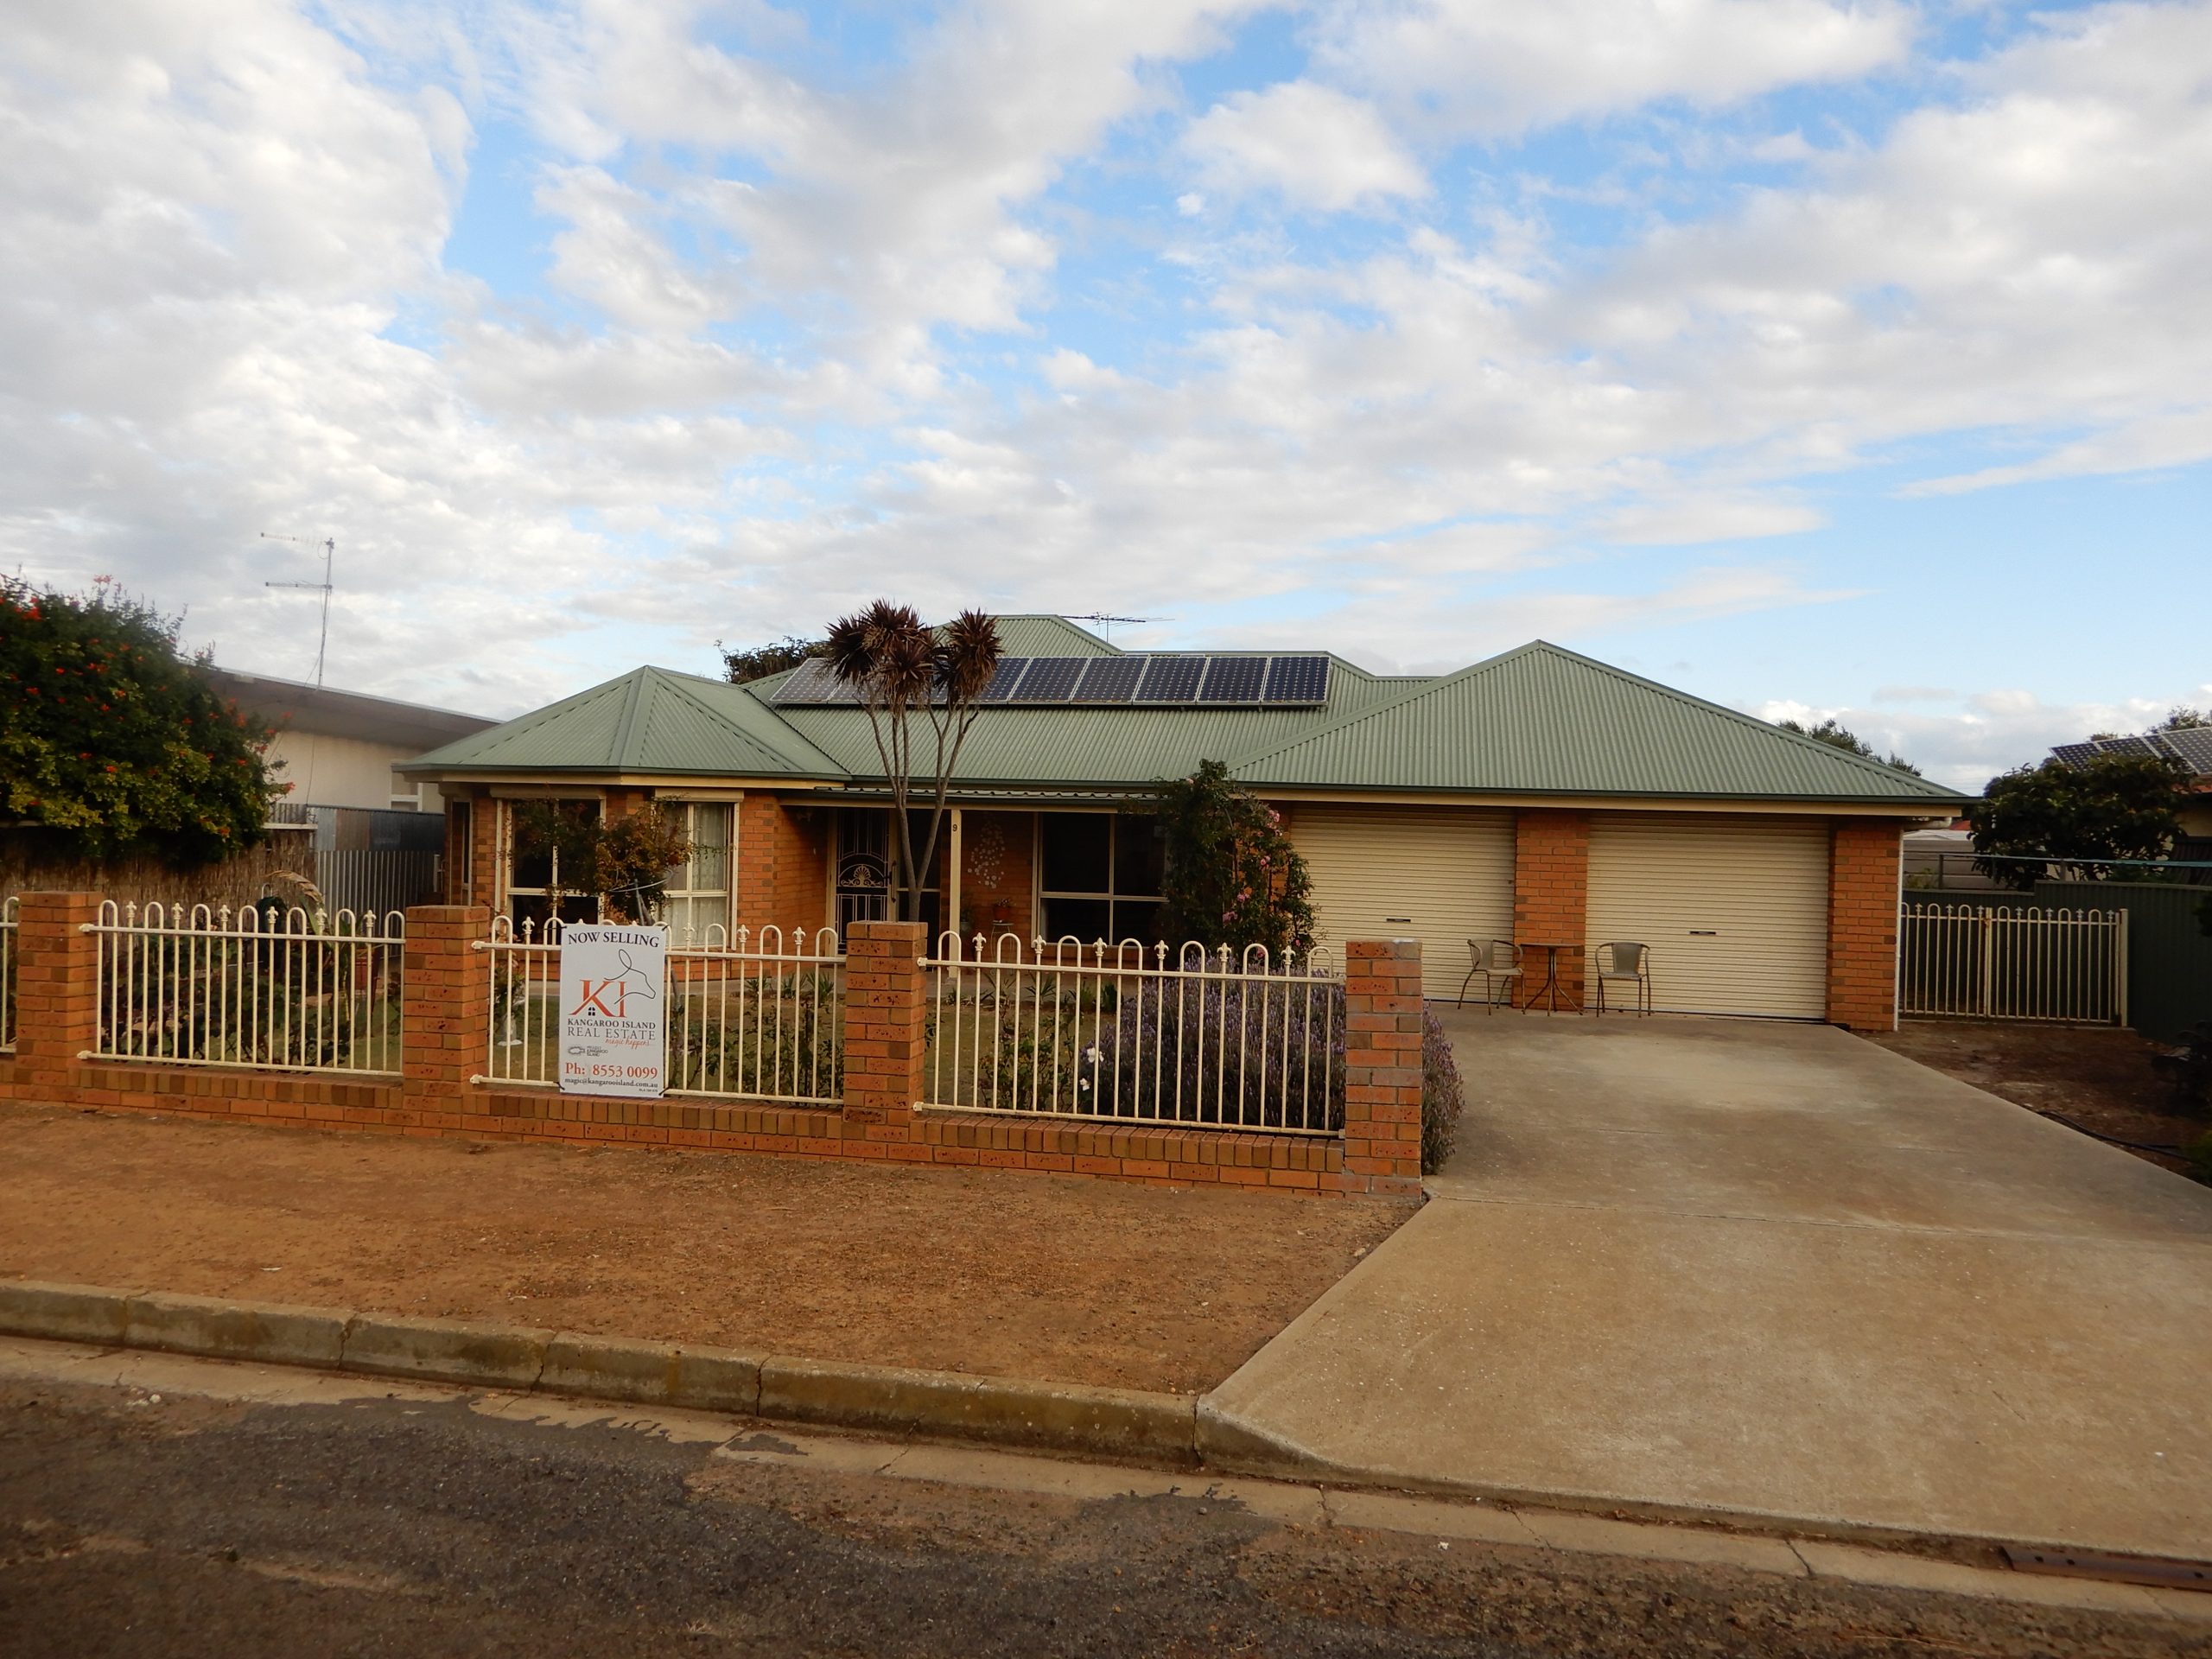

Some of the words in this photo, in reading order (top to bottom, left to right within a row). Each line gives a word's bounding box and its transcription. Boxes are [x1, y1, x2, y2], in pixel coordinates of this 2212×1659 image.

[952, 823, 957, 832] 9
[569, 932, 600, 944] NOW
[603, 932, 659, 947] SELLING
[569, 979, 627, 1018] KI
[568, 1019, 619, 1027] KANGAROO
[568, 1027, 600, 1037] REAL
[606, 1028, 656, 1040] ESTATE
[566, 1063, 585, 1075] Ph:
[593, 1064, 623, 1077] 8553
[627, 1065, 658, 1080] 0099
[564, 1077, 658, 1089] magic@kangarooisland.com.au
